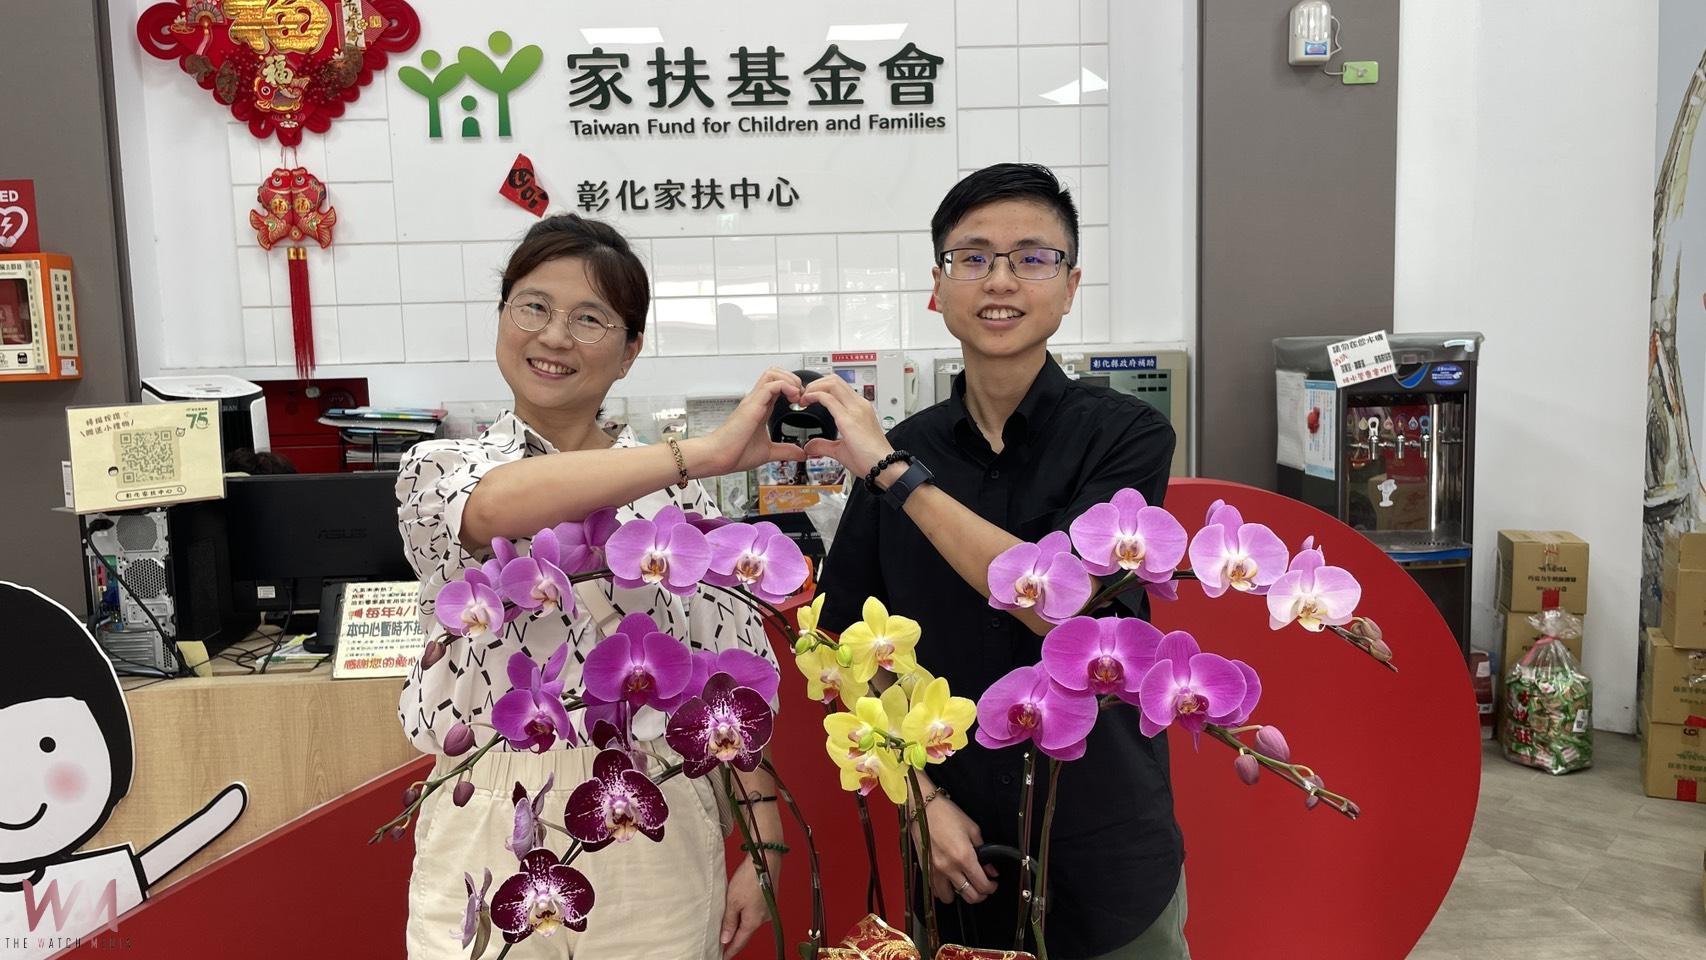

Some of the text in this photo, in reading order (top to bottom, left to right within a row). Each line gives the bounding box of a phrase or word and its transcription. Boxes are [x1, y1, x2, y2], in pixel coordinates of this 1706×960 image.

[262, 54, 294, 87] 福
[566, 42, 945, 110] 家扶基金會
[570, 112, 947, 137] Taiwan Fund for Children and Families
[576, 176, 800, 213] 彰化家扶中心
[1092, 358, 1155, 369] 彰化縣政府補助
